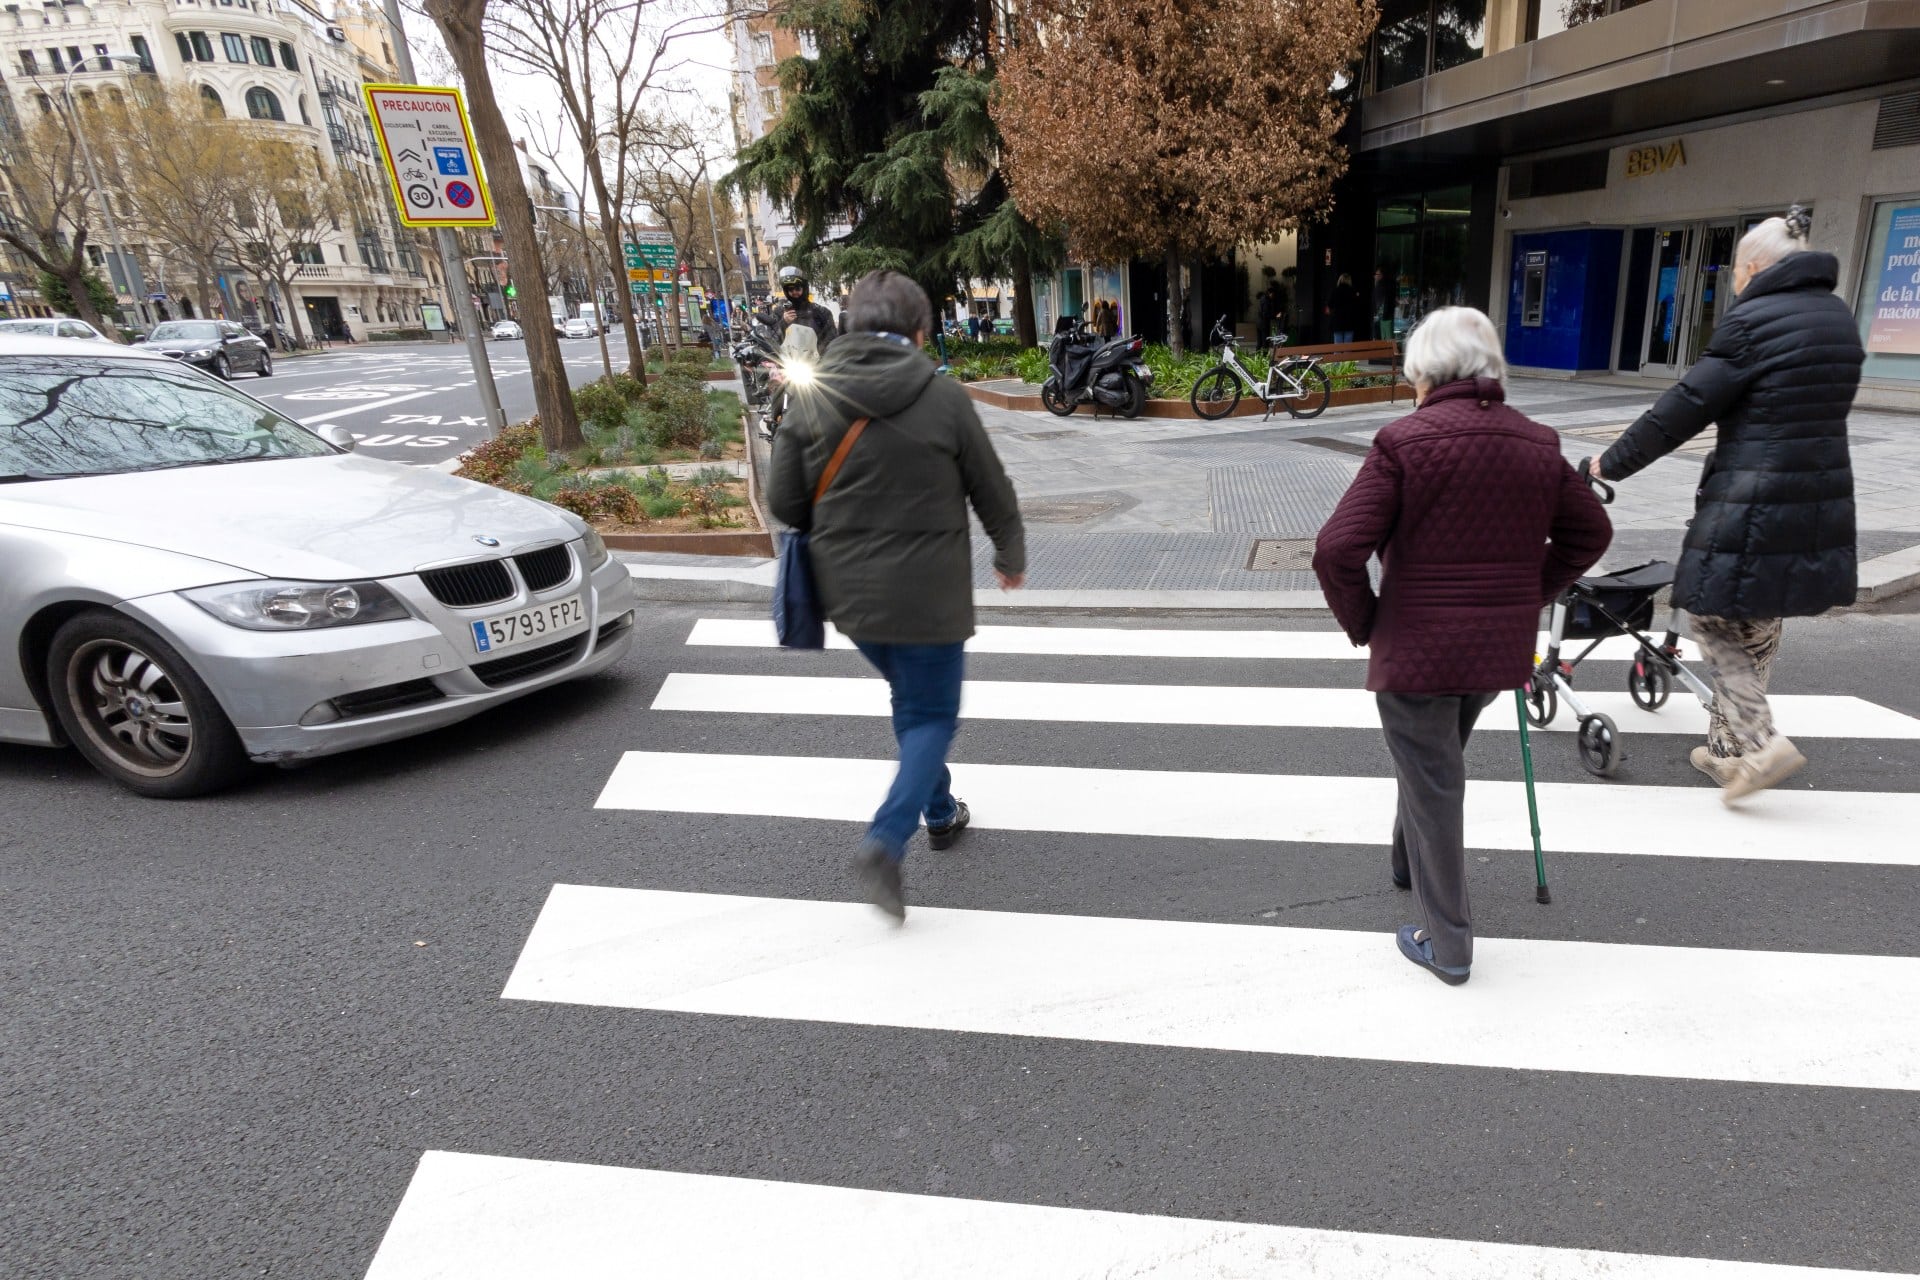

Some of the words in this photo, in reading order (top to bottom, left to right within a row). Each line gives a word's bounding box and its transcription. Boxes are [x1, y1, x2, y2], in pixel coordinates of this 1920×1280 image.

[382, 99, 451, 112] PRECAUCIÓN
[1625, 138, 1687, 178] BBVA
[413, 192, 429, 201] 30
[1903, 236, 1920, 248] m
[1881, 286, 1899, 302] de
[1900, 286, 1913, 302] la
[381, 413, 488, 427] TAX
[351, 432, 460, 447] US
[479, 638, 487, 647] E
[490, 611, 546, 643] 5793
[549, 599, 582, 628] FPZ
